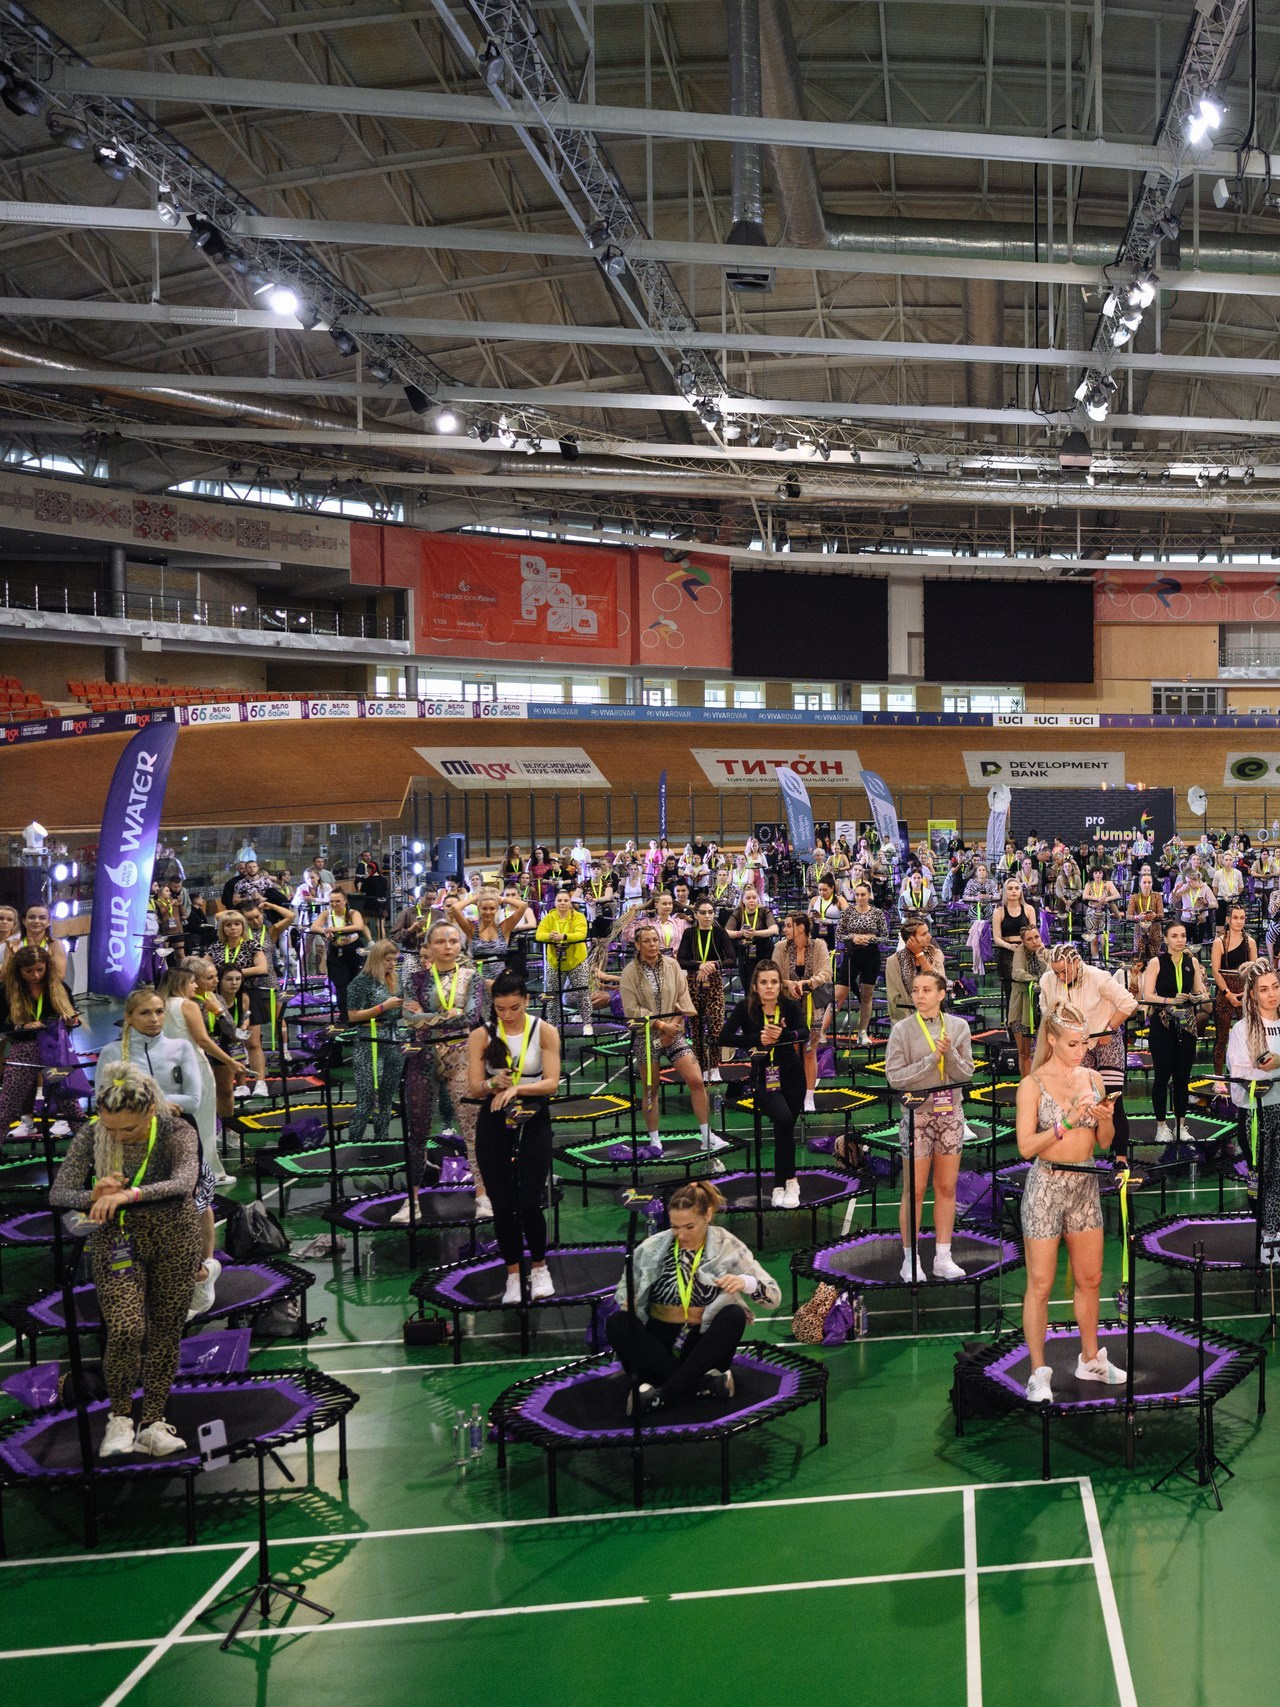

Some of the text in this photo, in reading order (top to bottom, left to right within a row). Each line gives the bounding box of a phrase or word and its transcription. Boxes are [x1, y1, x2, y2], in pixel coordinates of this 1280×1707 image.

[1003, 716, 1023, 724] UCI
[1038, 717, 1058, 725] UCI
[1074, 717, 1094, 725] UCI
[120, 750, 158, 852] WATER
[1086, 816, 1105, 827] pro
[1092, 826, 1155, 844] Jumpig
[104, 896, 131, 975] YOUR
